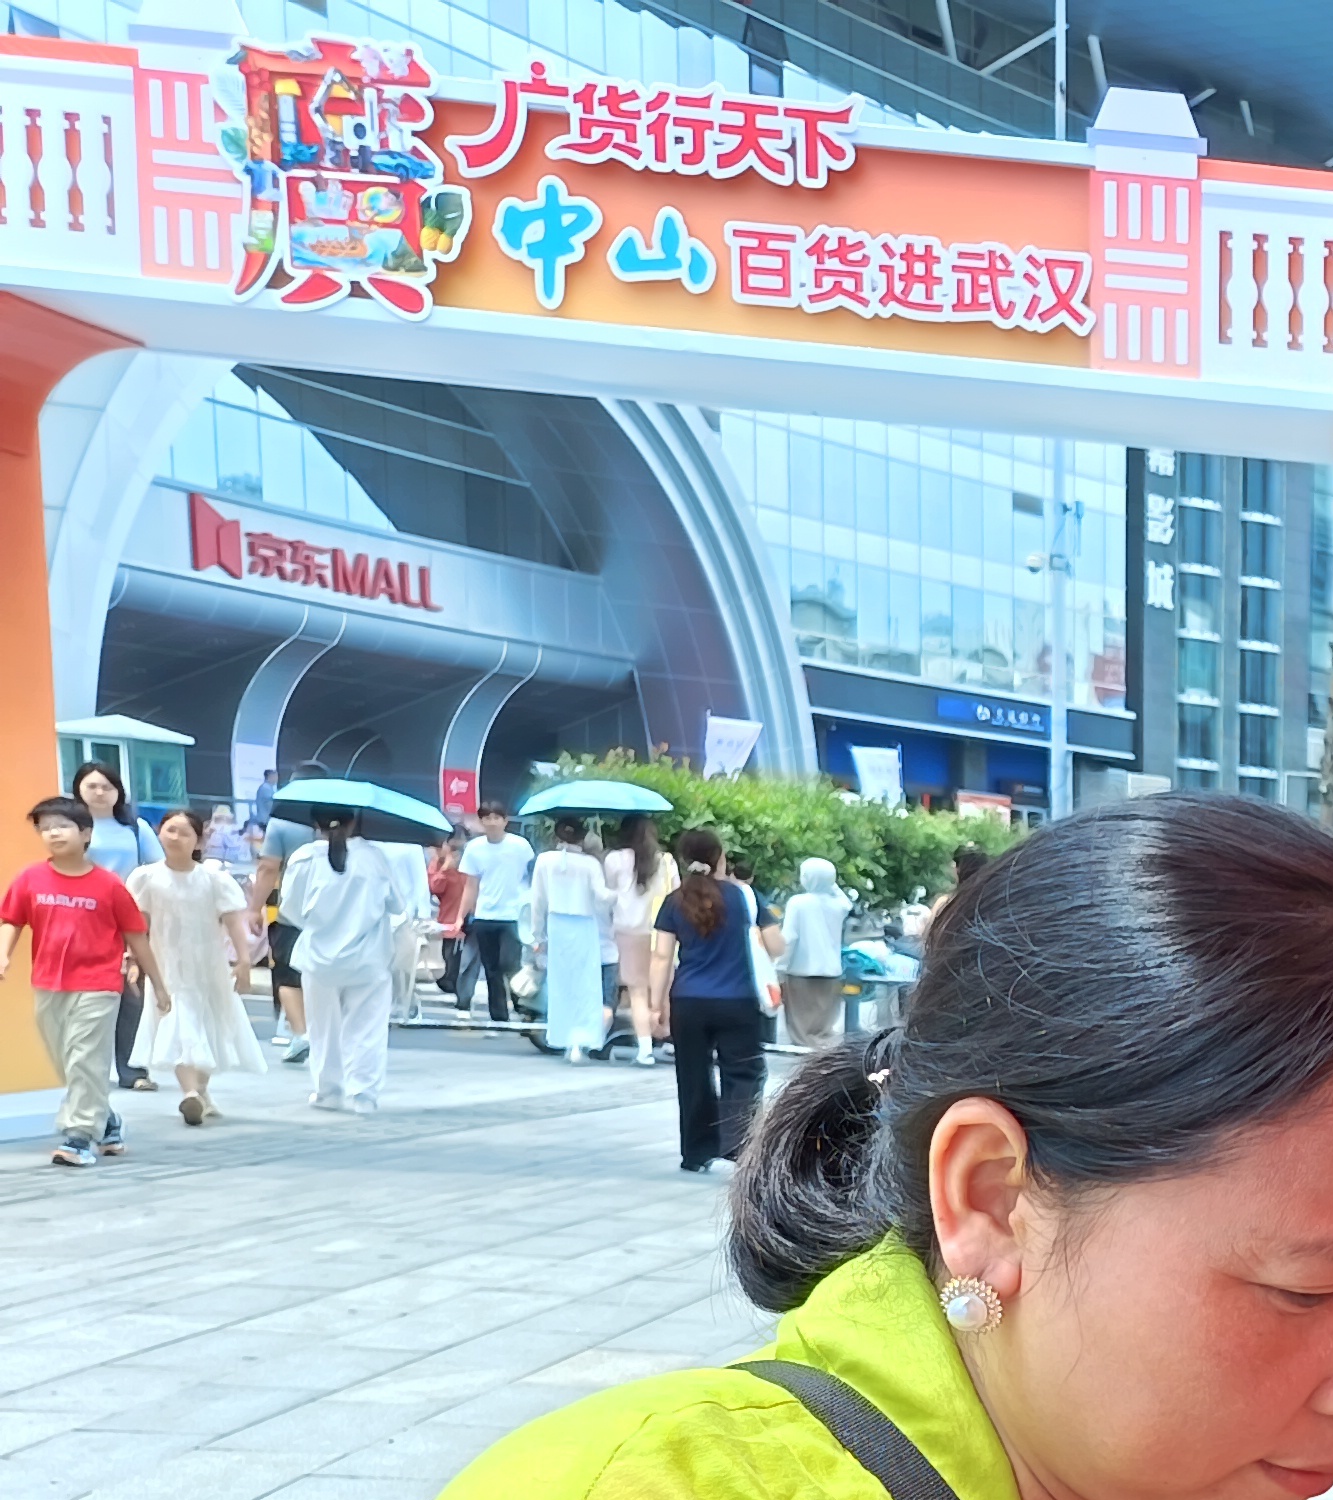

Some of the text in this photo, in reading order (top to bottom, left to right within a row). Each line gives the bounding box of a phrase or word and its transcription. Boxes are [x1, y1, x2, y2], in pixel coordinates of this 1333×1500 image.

[458, 60, 853, 182] 广货行天下
[500, 183, 1088, 328] 中山 百货进武汉
